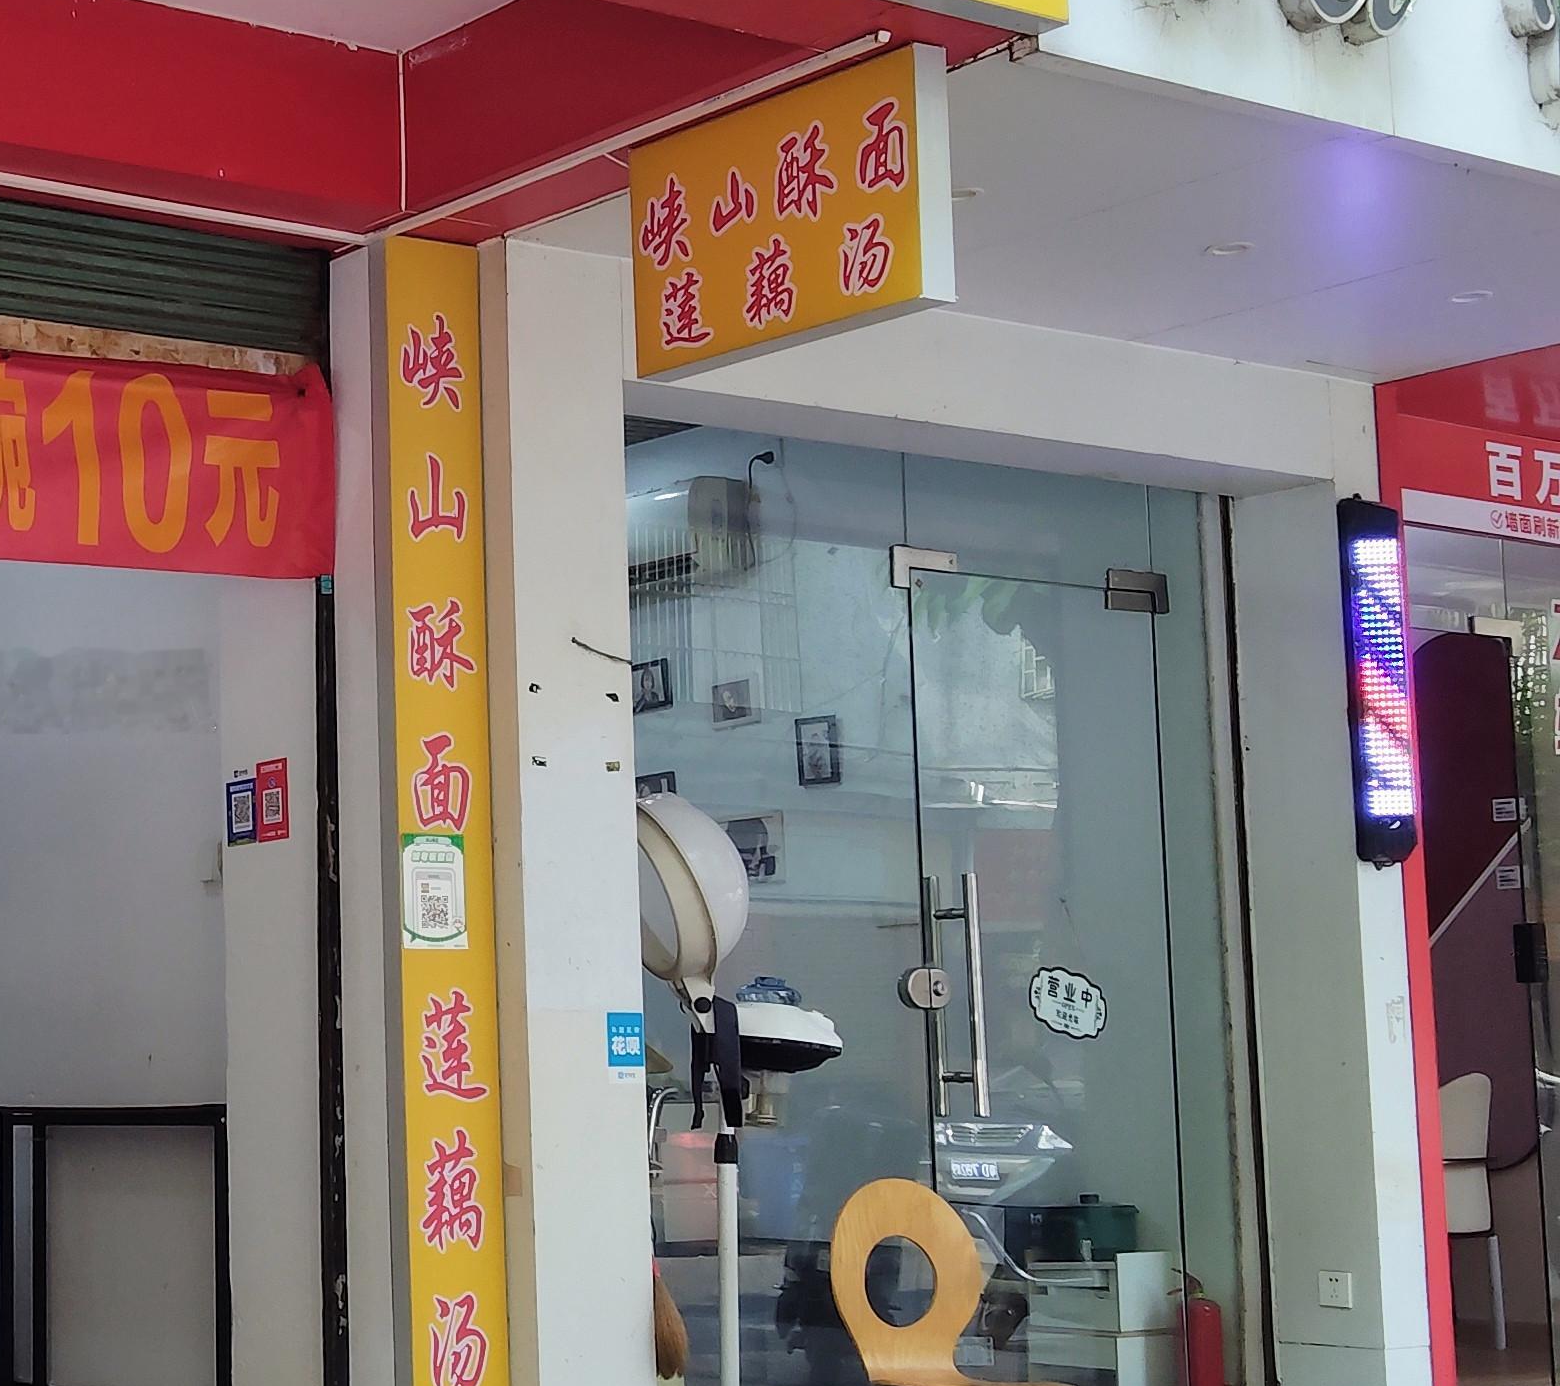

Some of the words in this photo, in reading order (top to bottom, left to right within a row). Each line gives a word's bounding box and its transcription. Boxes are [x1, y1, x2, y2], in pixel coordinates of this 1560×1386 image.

[638, 96, 908, 271] 峡山酥面
[660, 212, 895, 350] 莲藕汤
